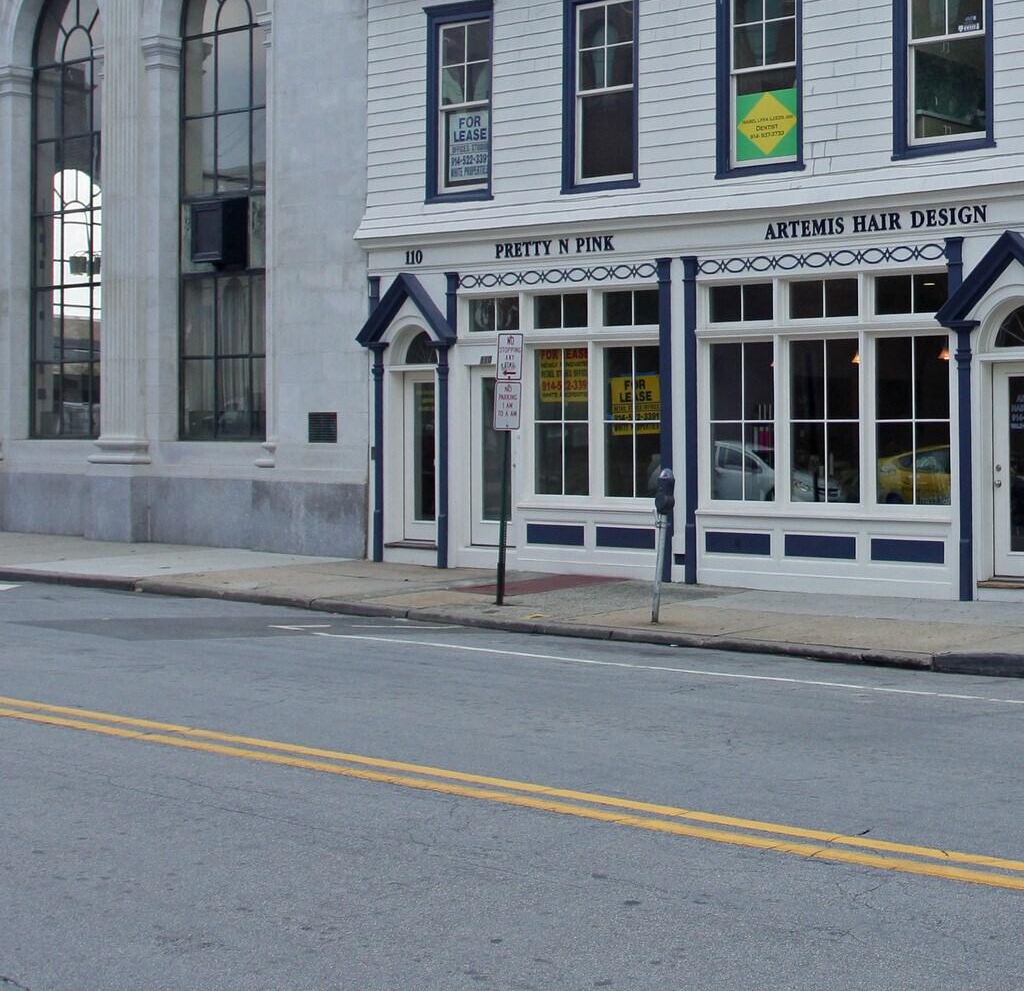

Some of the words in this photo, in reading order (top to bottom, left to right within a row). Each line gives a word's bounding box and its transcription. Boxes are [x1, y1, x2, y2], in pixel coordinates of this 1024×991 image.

[459, 116, 481, 129] FOR
[454, 128, 487, 143] LEASE
[451, 154, 488, 167] 914-522-339
[764, 217, 845, 240] ARTEMIS
[852, 212, 902, 233] HAIR
[910, 205, 987, 228] DESIGN
[495, 240, 552, 259] PRETTY
[559, 238, 569, 254] N
[575, 235, 615, 253] PINK
[405, 250, 423, 265] 110
[507, 336, 514, 345] NO
[541, 349, 559, 360] FOR
[542, 379, 588, 391] 914-52-339
[624, 379, 646, 390] FOR
